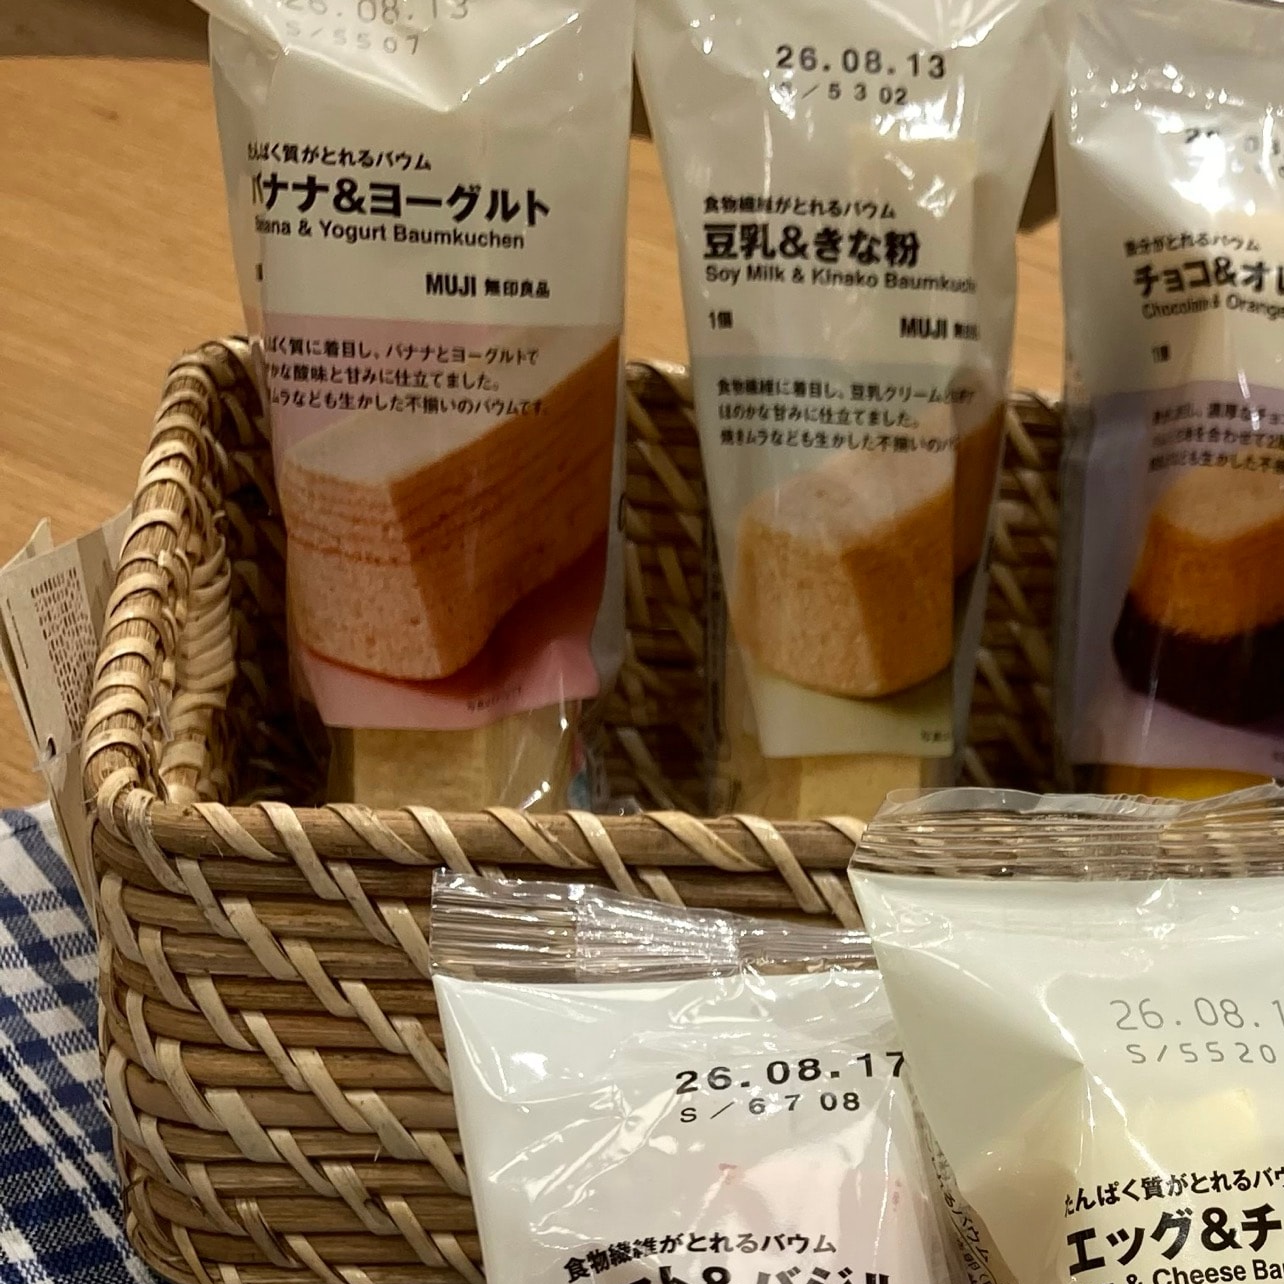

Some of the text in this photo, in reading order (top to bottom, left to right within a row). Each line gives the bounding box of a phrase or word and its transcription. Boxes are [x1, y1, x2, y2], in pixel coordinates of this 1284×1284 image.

[776, 45, 946, 79] 26.08.13
[298, 218, 312, 237] &
[319, 219, 386, 244] Yogurt
[394, 228, 525, 250] Baumkuchen
[703, 223, 921, 267] 豆乳&きな粉
[425, 273, 550, 298] MUJI 無印良品
[705, 265, 741, 286] Soy
[747, 265, 785, 283] Milk
[791, 268, 804, 283] &
[812, 267, 879, 288] Kinako
[900, 316, 948, 339] MUJI
[675, 1050, 905, 1095] 26.08.17
[564, 1232, 837, 1283] 食物繊維がとれるバウム
